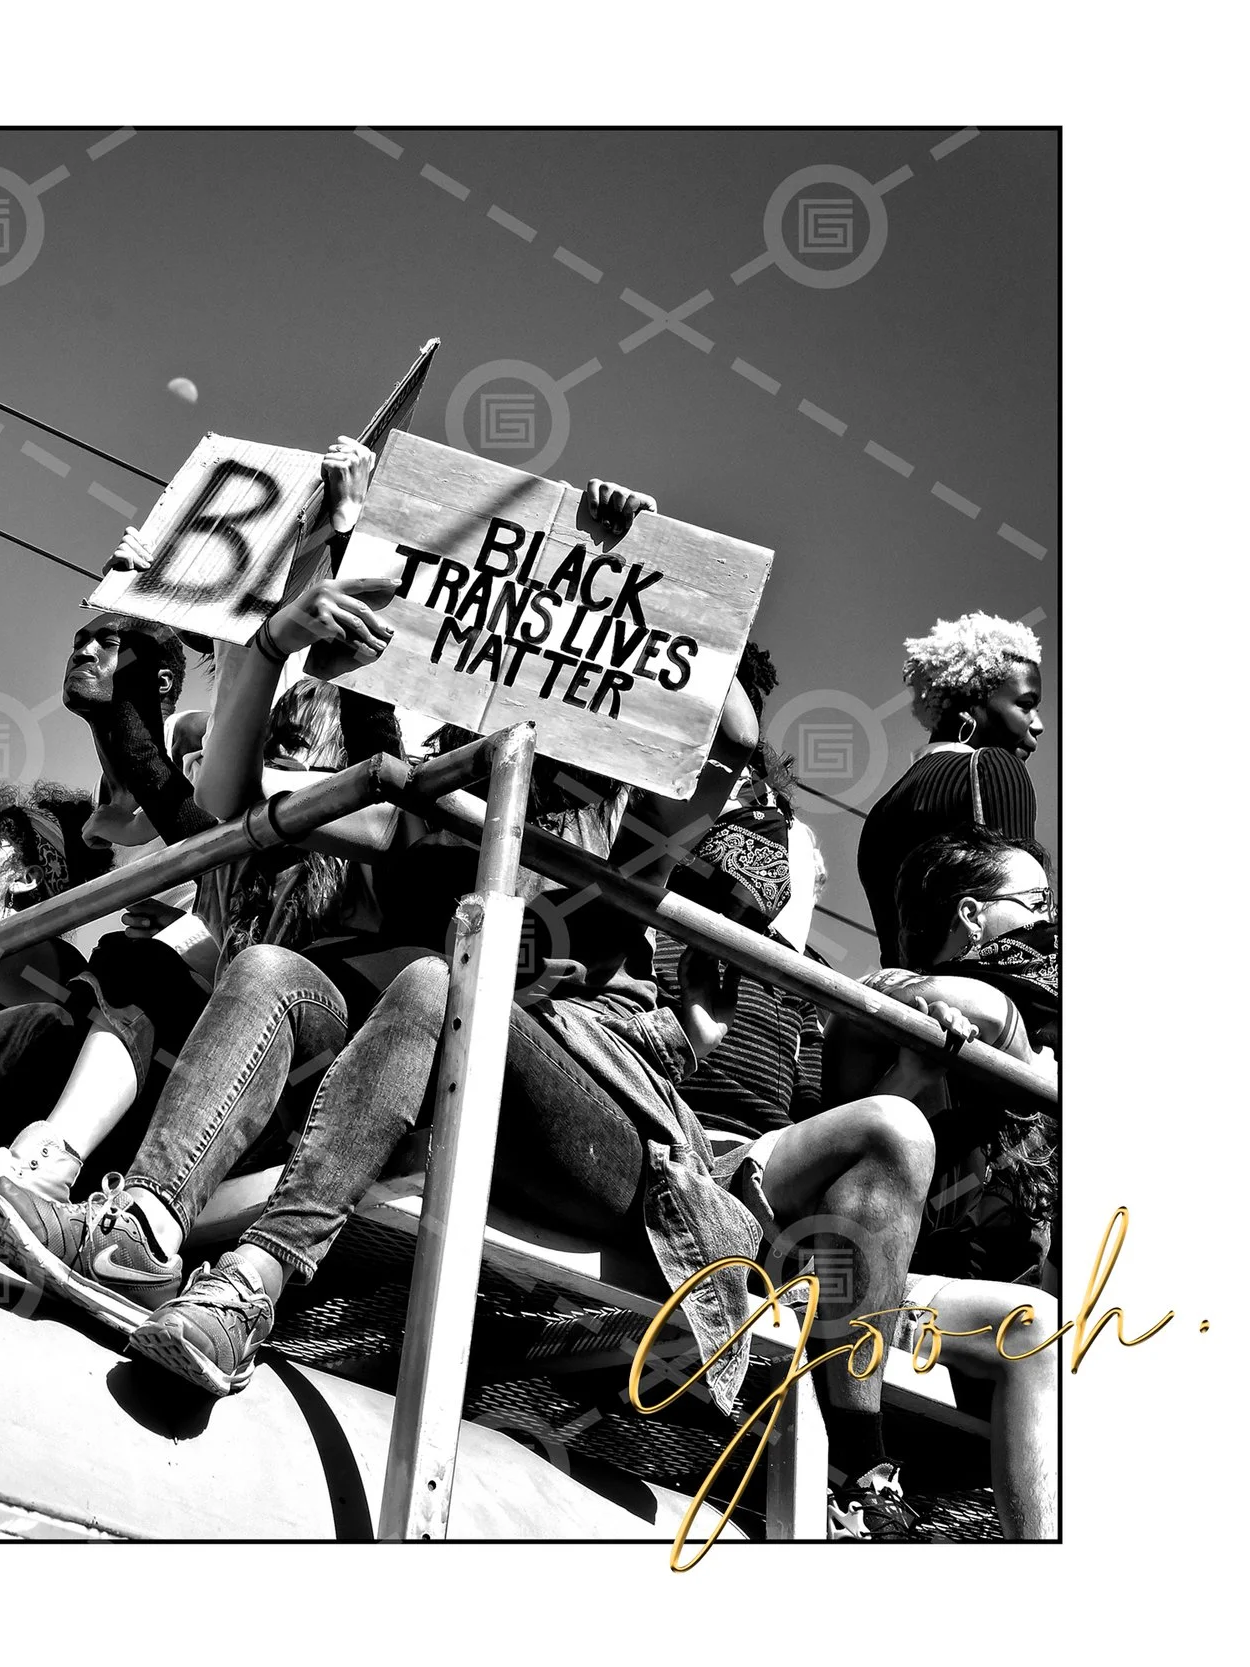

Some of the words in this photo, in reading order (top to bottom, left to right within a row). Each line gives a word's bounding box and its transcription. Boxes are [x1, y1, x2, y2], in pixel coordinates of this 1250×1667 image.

[395, 543, 562, 644] TRANS
[560, 604, 699, 692] LIVES
[473, 516, 664, 629] BLACK
[431, 616, 635, 720] MATTER
